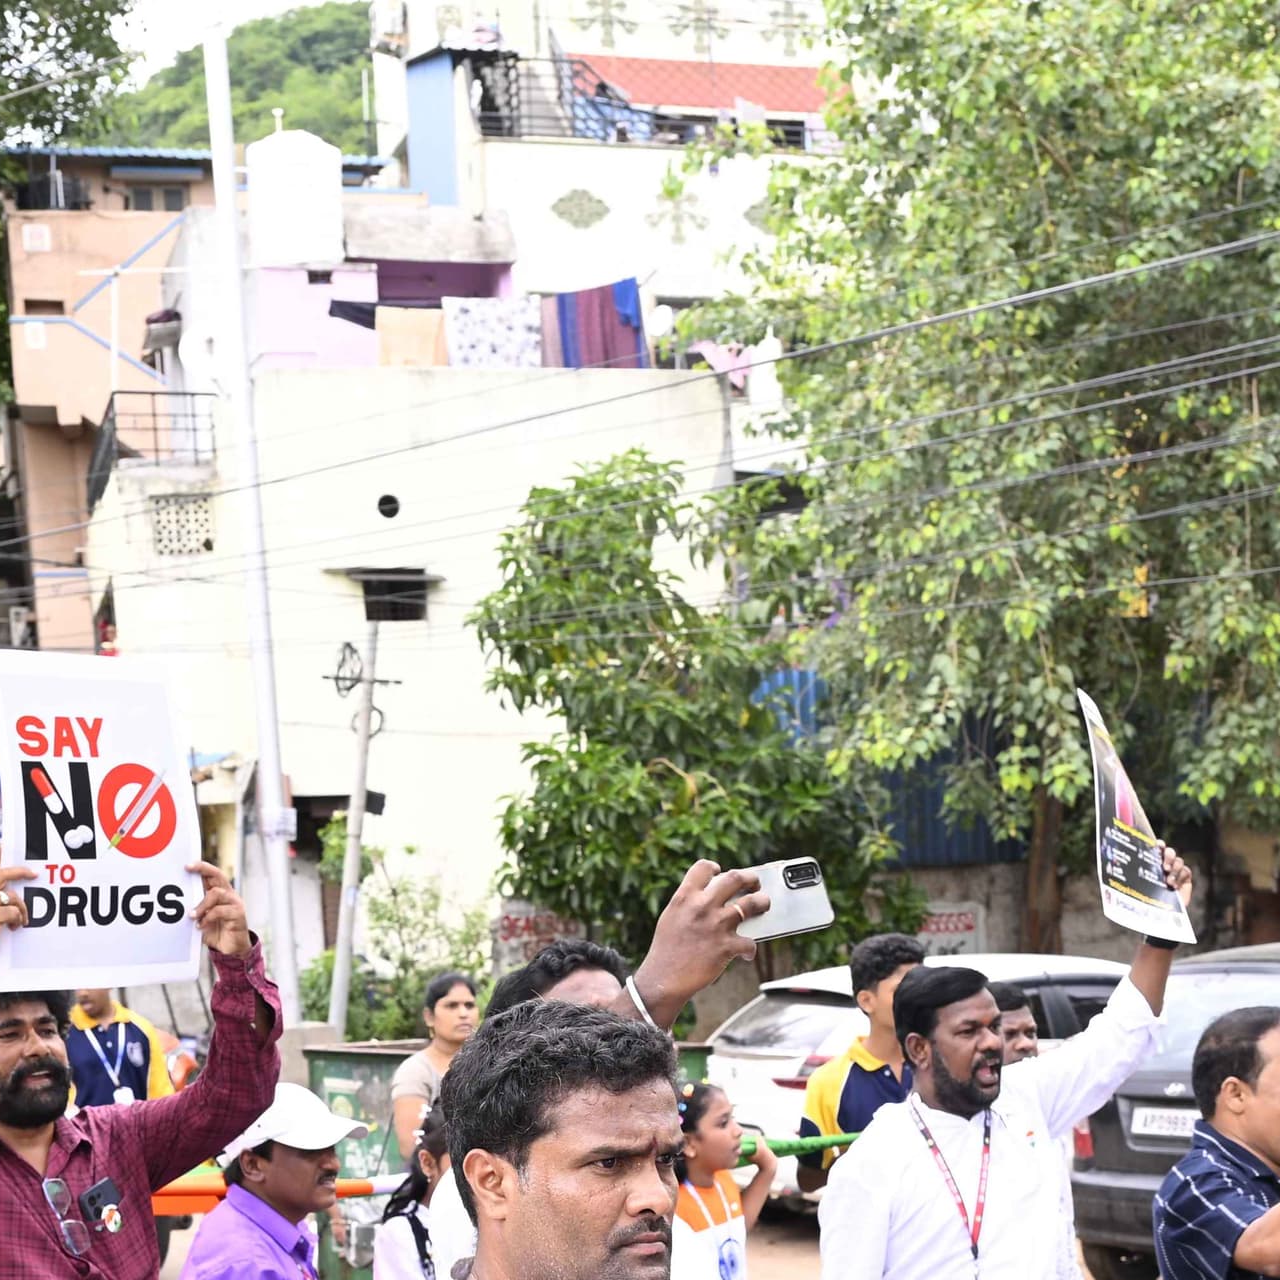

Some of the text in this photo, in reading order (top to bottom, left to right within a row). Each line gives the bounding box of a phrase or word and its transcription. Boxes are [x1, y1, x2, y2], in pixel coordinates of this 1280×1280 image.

[15, 715, 104, 758] SAY
[20, 761, 177, 860] NO
[44, 863, 77, 884] TO
[23, 884, 186, 928] DRUGS
